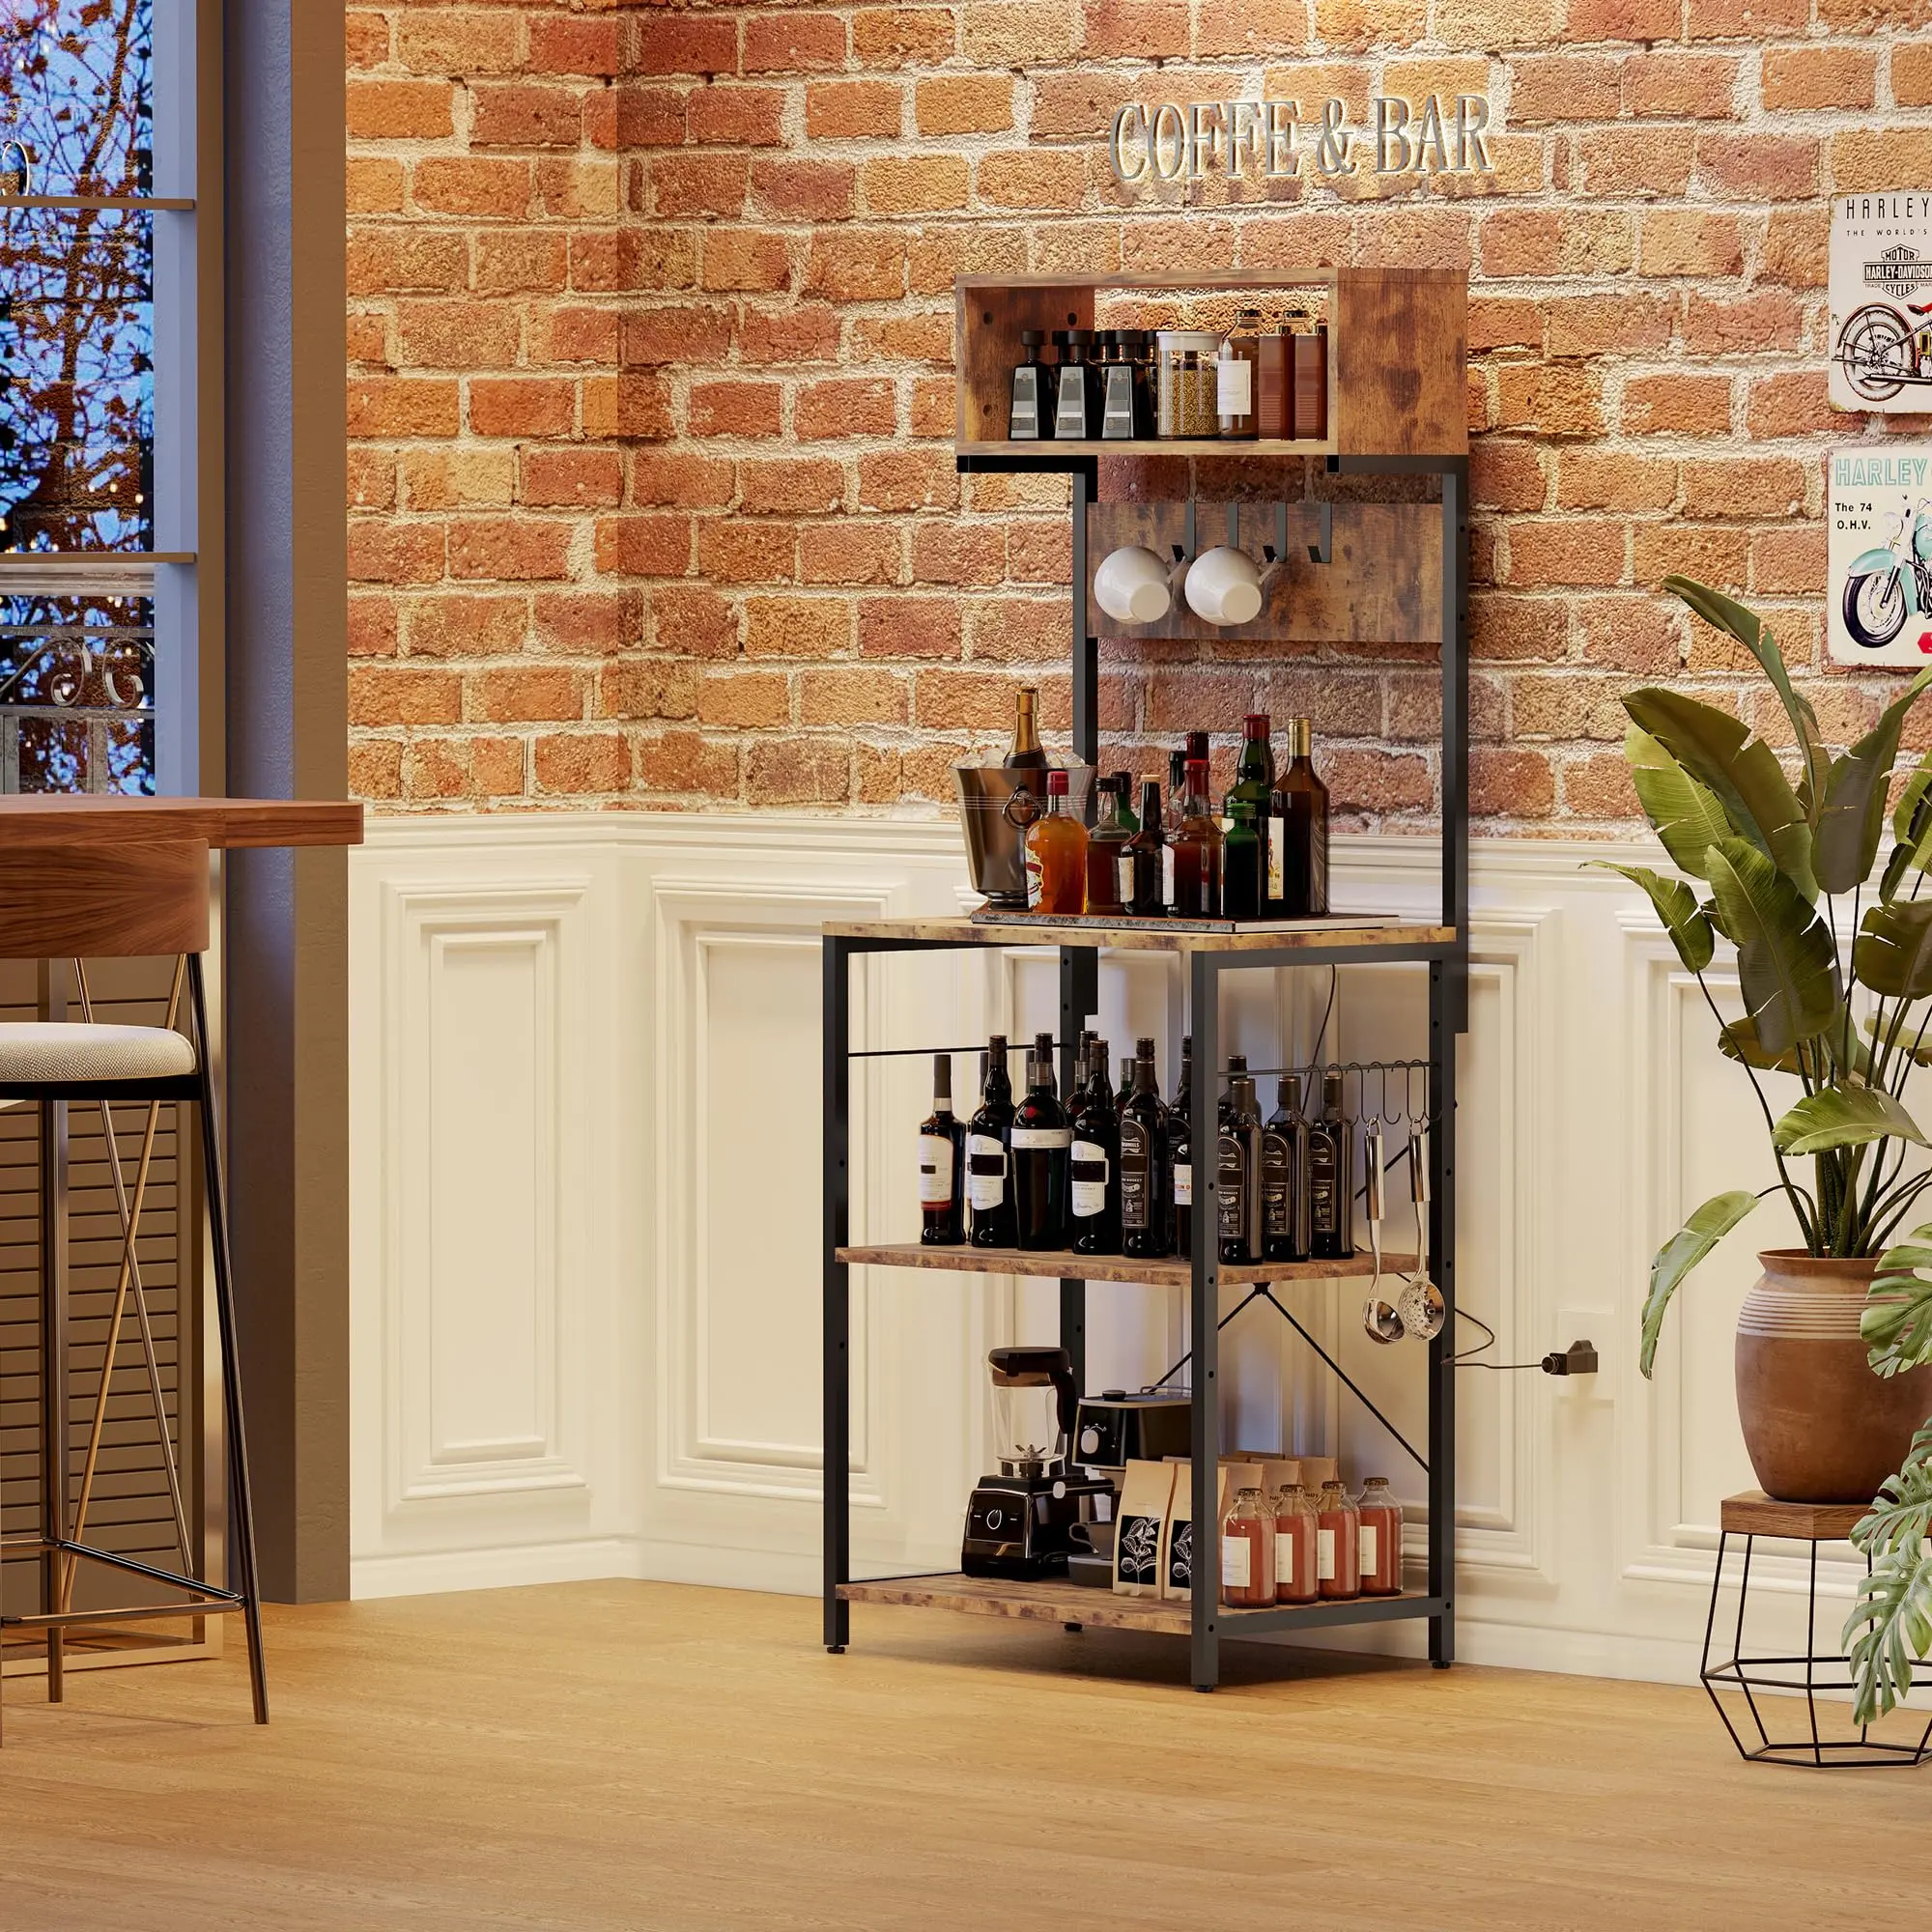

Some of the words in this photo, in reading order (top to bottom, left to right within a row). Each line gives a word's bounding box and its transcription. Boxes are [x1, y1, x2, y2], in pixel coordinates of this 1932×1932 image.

[1109, 100, 1301, 181] COFFE
[1317, 99, 1357, 175] &
[1373, 95, 1493, 174] BAR
[1847, 198, 1929, 219] HARLEY
[1876, 228, 1927, 237] WORLD'S
[1885, 247, 1915, 261] MOTOR
[1865, 265, 1932, 280] HARLEY-DAVIDSO
[1885, 283, 1916, 298] CYCLES
[1836, 459, 1927, 486] HARLEY
[1835, 502, 1855, 513] The
[1860, 502, 1873, 513] 74
[1836, 520, 1871, 530] O.H.V.
